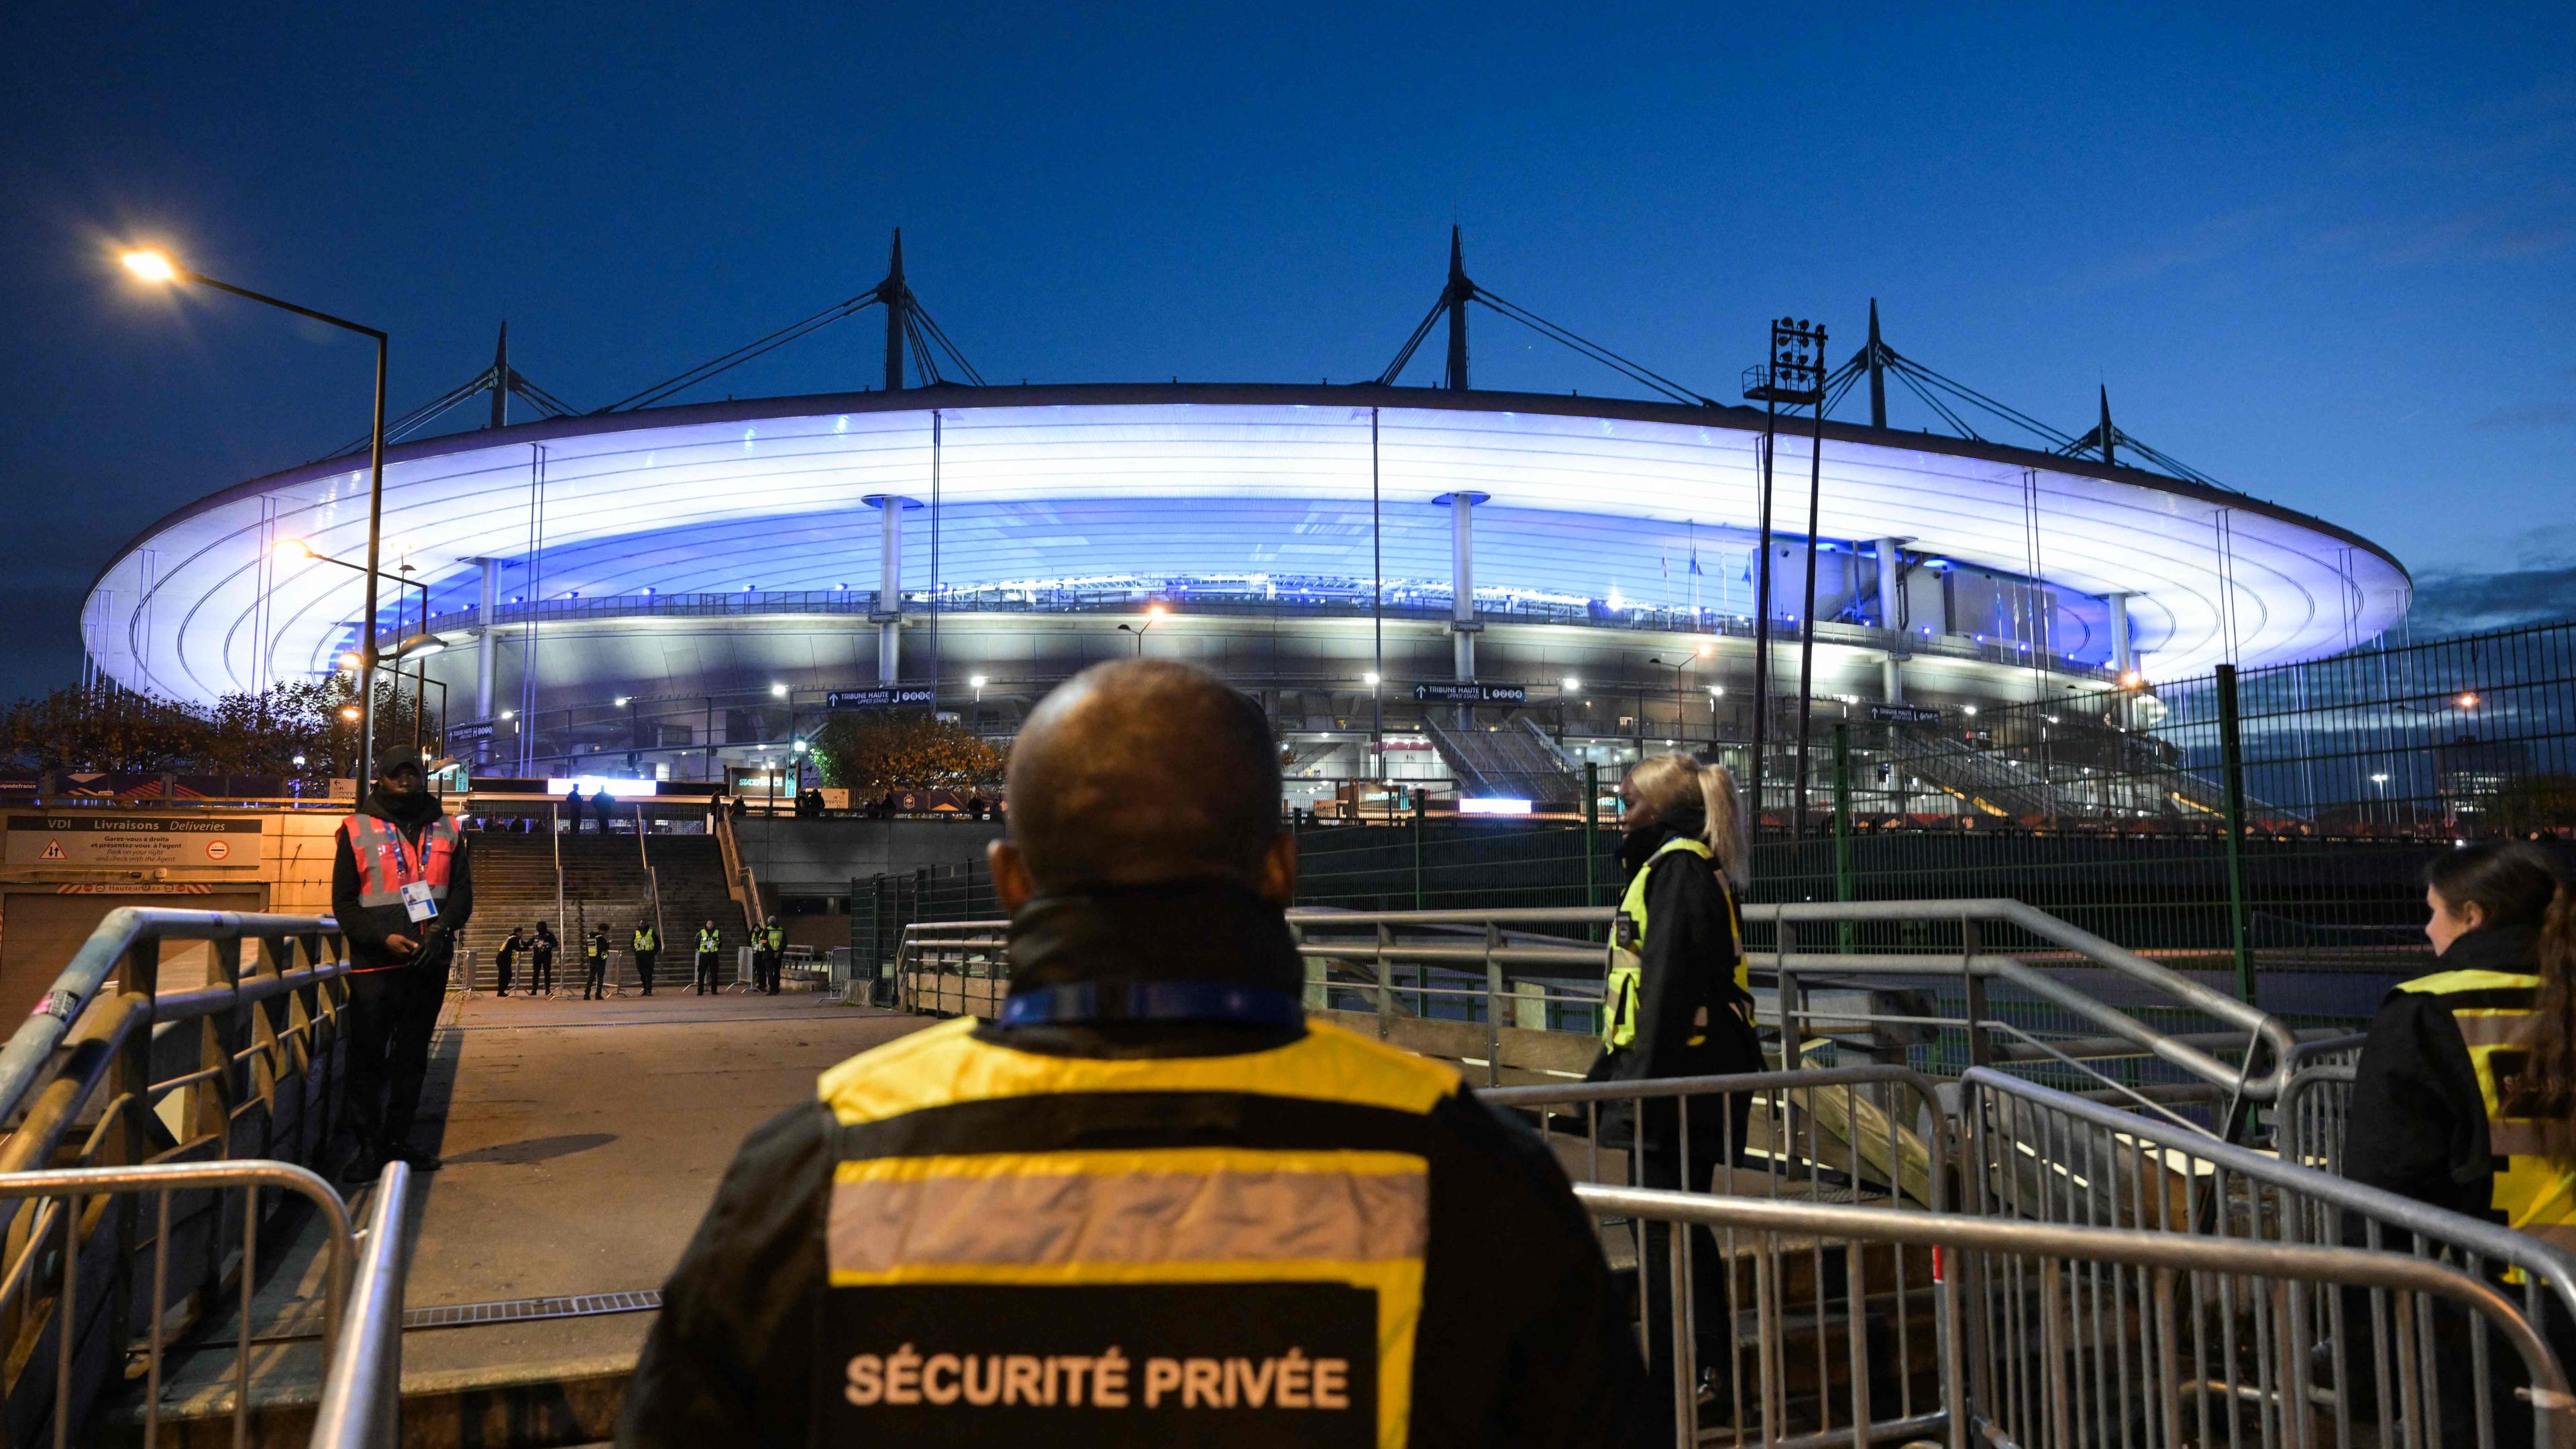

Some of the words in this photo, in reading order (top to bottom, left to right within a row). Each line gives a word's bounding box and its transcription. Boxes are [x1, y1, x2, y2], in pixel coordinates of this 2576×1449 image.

[892, 690, 900, 703] J
[1483, 688, 1489, 700] L
[460, 763, 467, 773] K
[788, 772, 794, 780] K
[48, 819, 70, 828] VDI
[94, 820, 159, 830] Livraisons
[170, 821, 225, 831] Deliveries
[845, 1342, 1131, 1408] SÉCURITÉ
[1144, 1346, 1351, 1409] PRIVÉE
